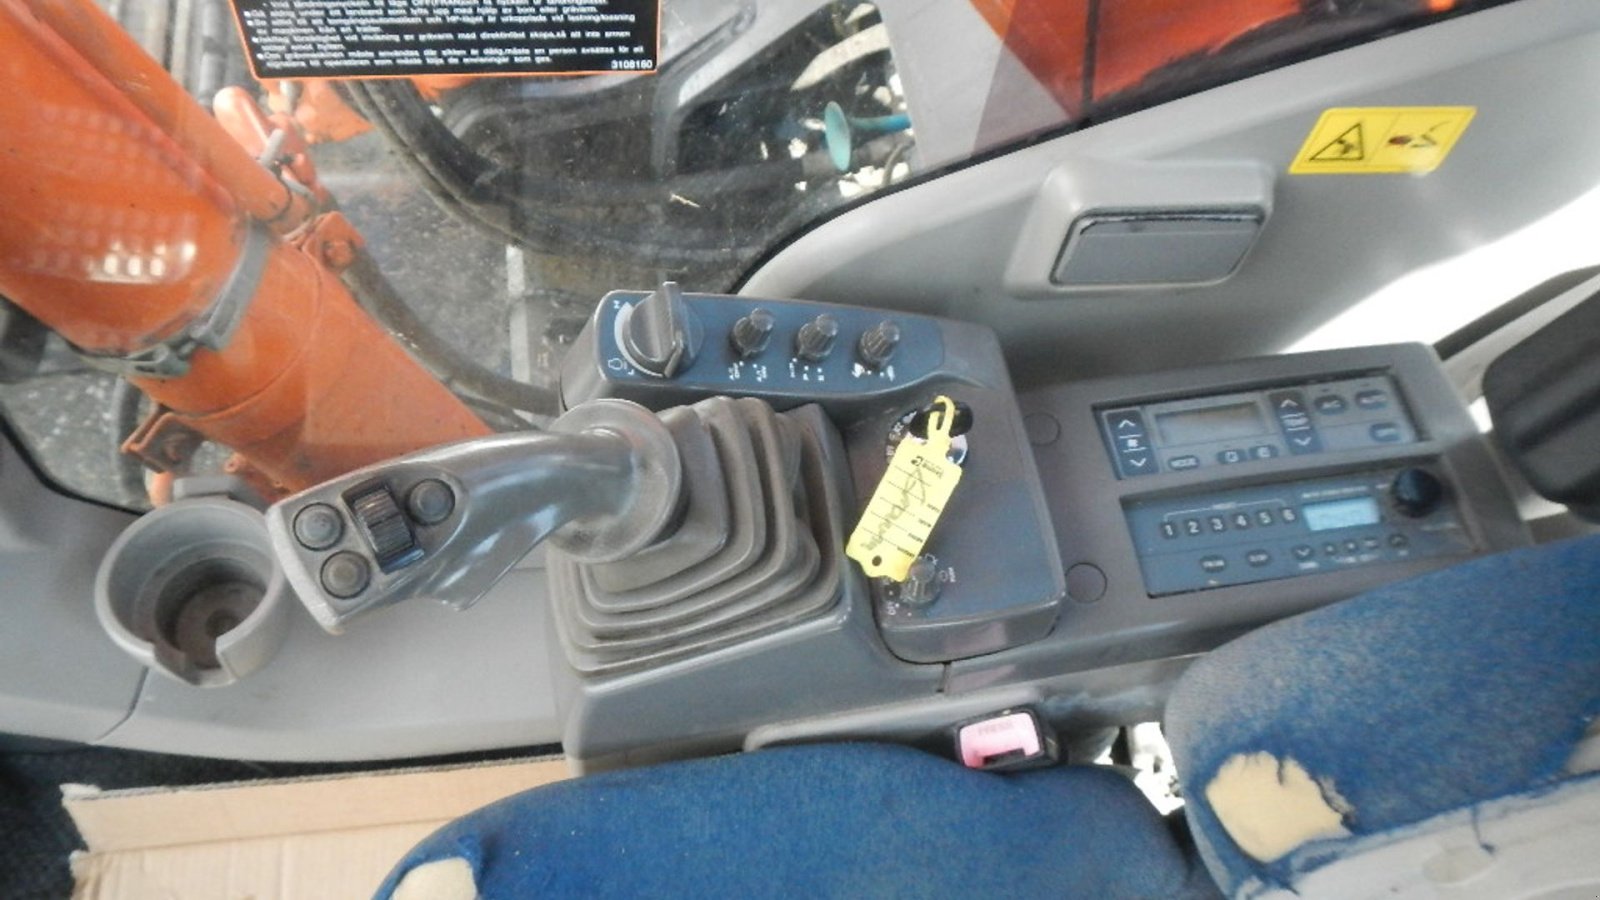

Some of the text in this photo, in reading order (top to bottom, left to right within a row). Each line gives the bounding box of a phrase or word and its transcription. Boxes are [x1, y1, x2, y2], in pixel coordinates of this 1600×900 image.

[611, 60, 653, 69] 3108160
[1164, 508, 1296, 536] 1 2 3 4 5 6
